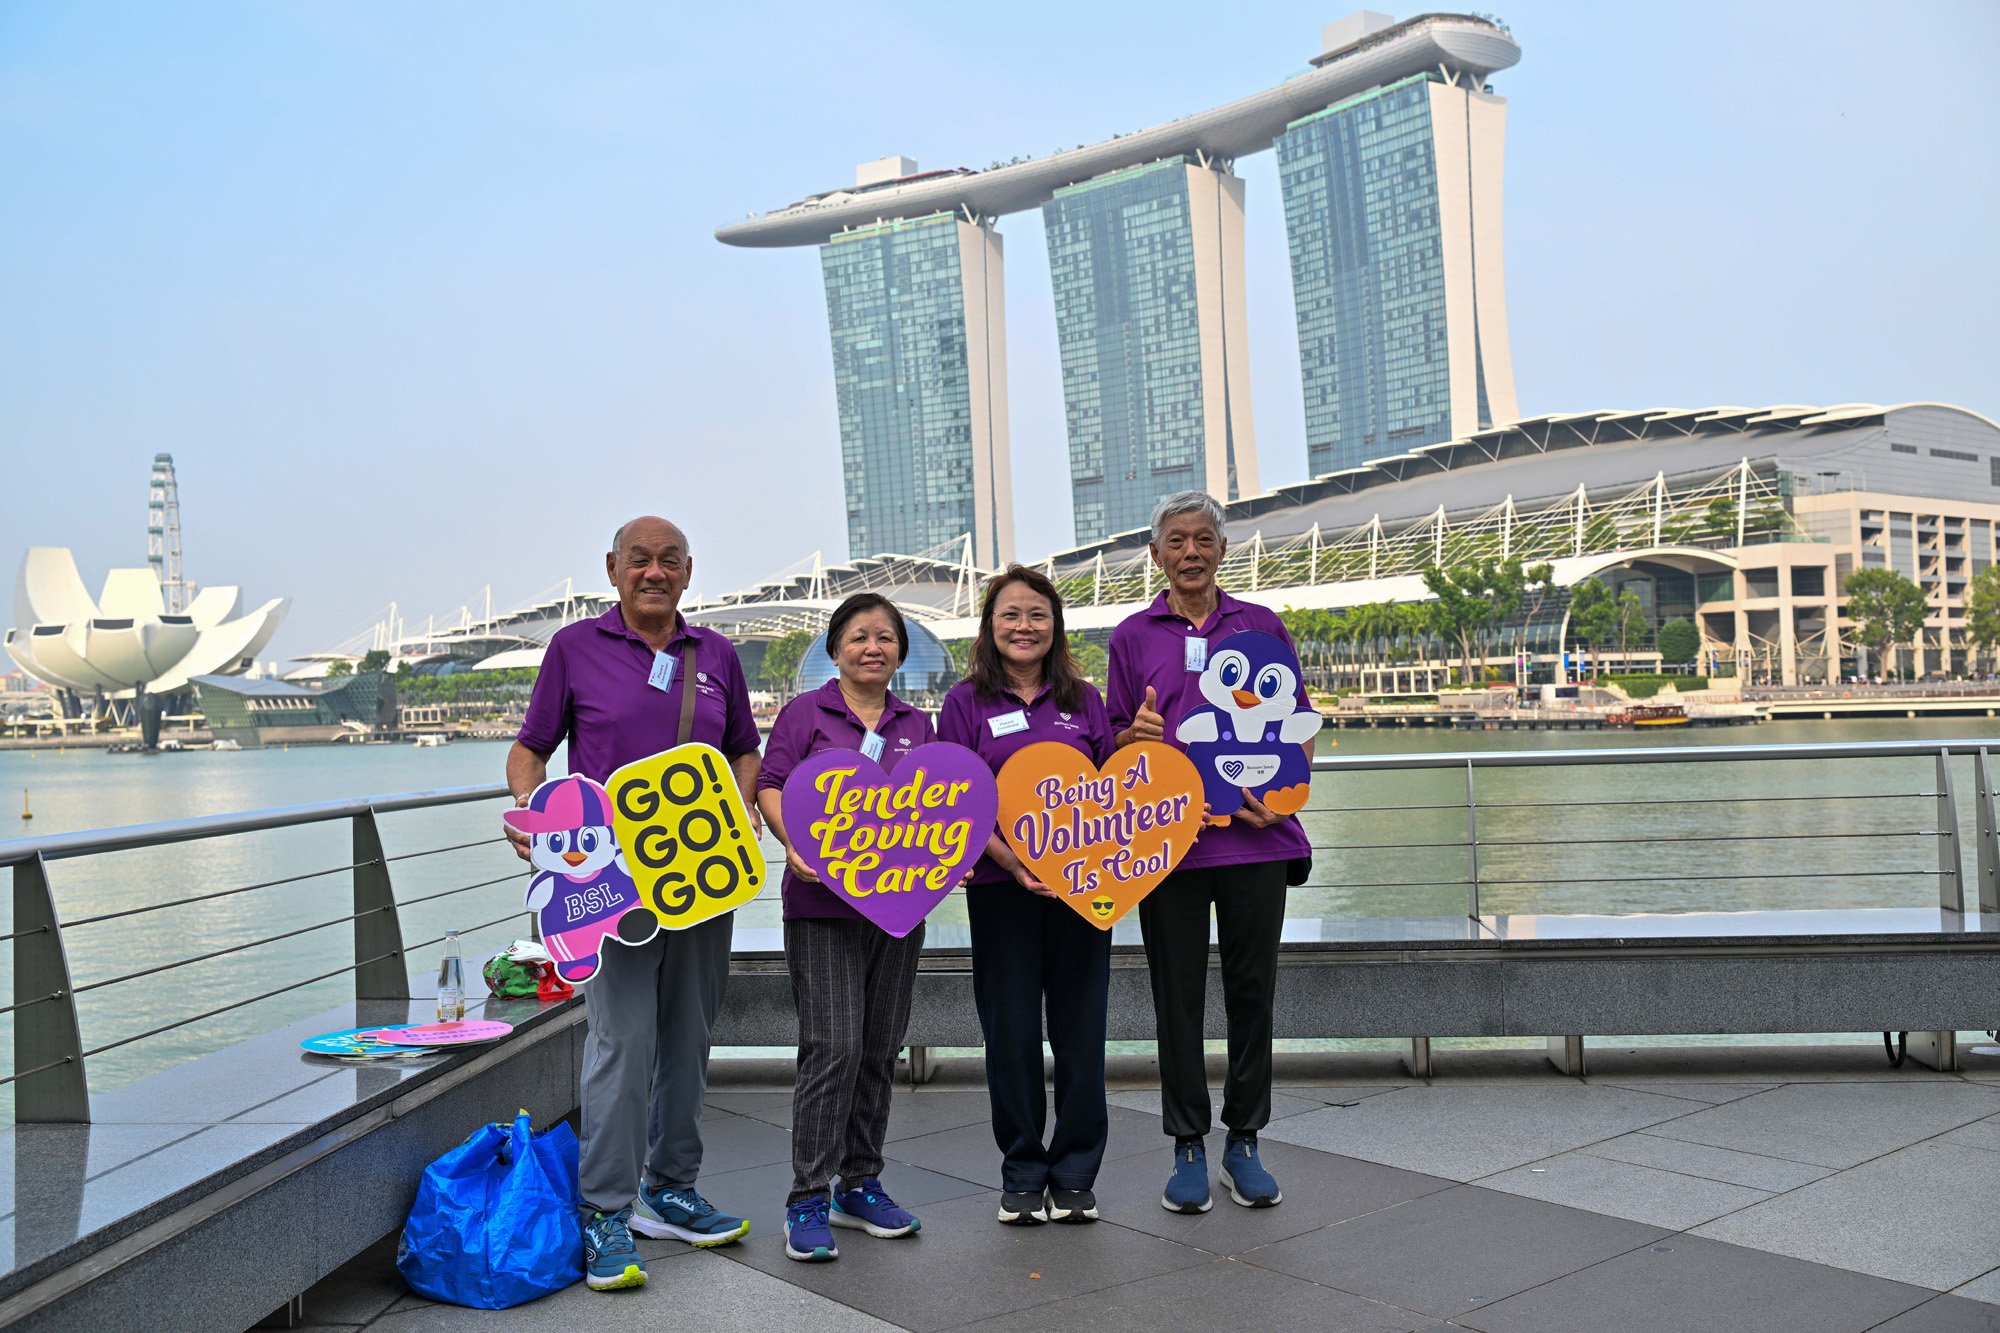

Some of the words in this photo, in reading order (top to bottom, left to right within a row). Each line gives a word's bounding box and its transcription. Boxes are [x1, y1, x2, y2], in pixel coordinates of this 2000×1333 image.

[616, 753, 723, 822] GO!
[814, 766, 972, 820] Tender
[1036, 775, 1115, 810] Being
[1122, 754, 1150, 790] A
[634, 798, 741, 869] GO!
[809, 811, 971, 867] Loving
[1013, 793, 1189, 861] Volunteer
[652, 845, 759, 915] GO!
[827, 851, 949, 898] Care
[1062, 859, 1098, 897] Is
[1101, 842, 1169, 882] Cool
[565, 883, 624, 922] BSL
